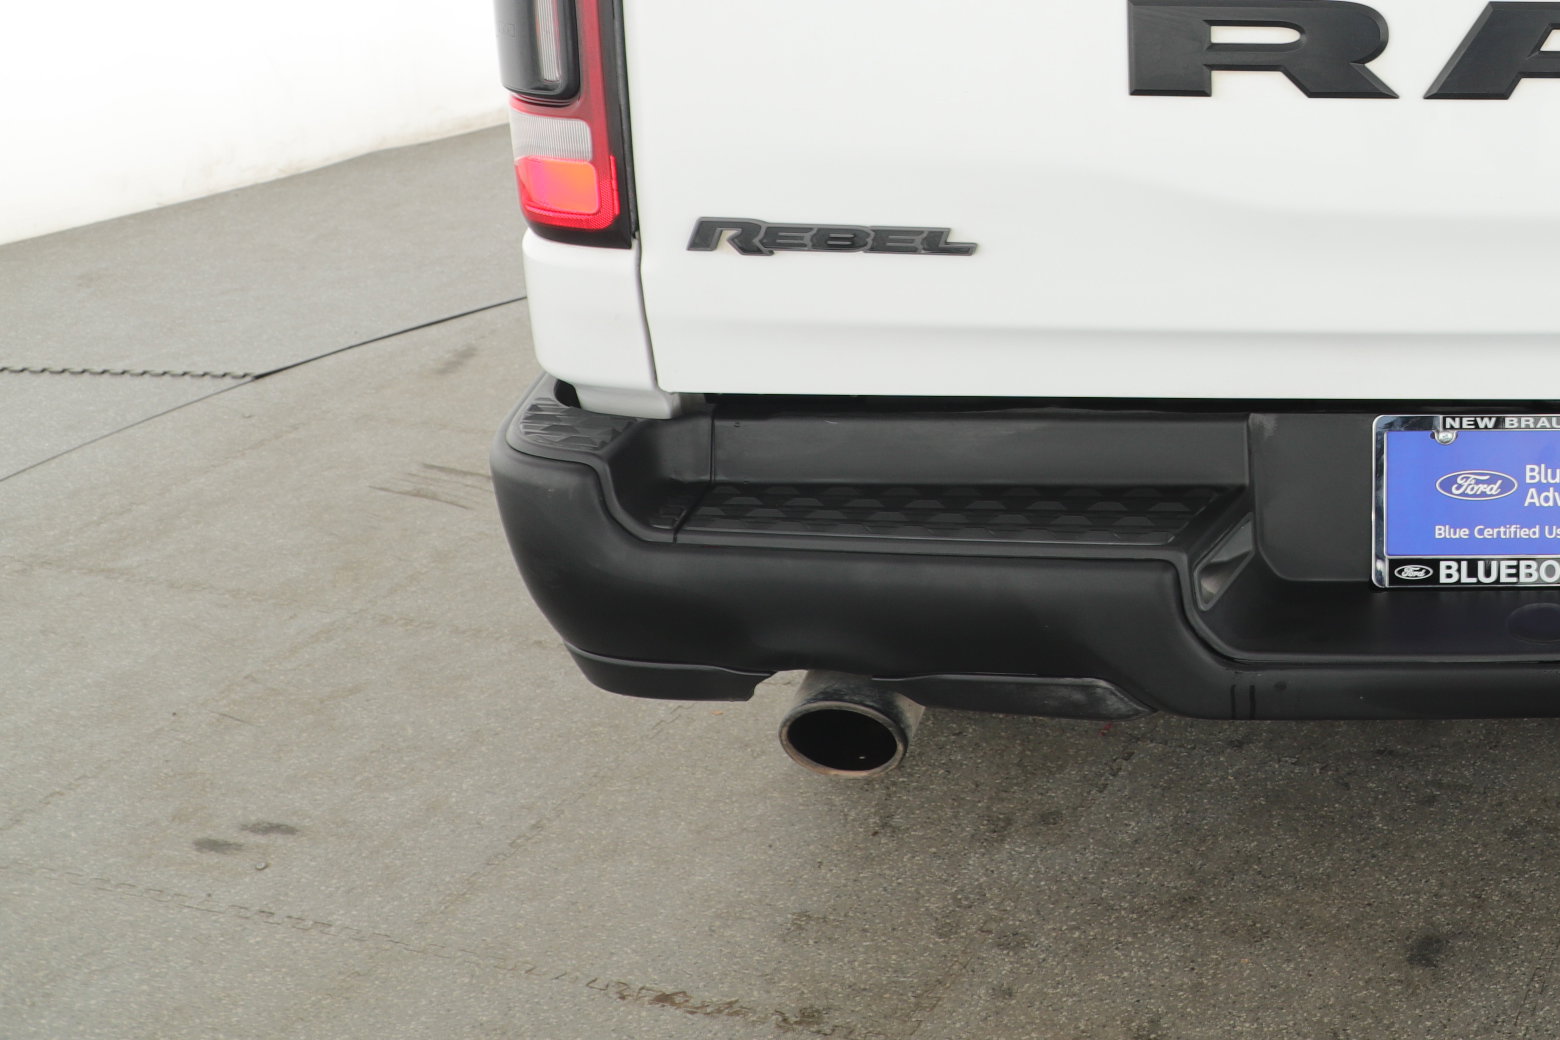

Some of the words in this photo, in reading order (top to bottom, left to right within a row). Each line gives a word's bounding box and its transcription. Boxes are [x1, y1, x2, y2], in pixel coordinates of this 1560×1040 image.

[686, 215, 978, 256] REBEL
[1445, 416, 1496, 429] NEW
[1451, 474, 1503, 496] Ford
[1434, 525, 1470, 539] Blue
[1474, 525, 1540, 539] Certified
